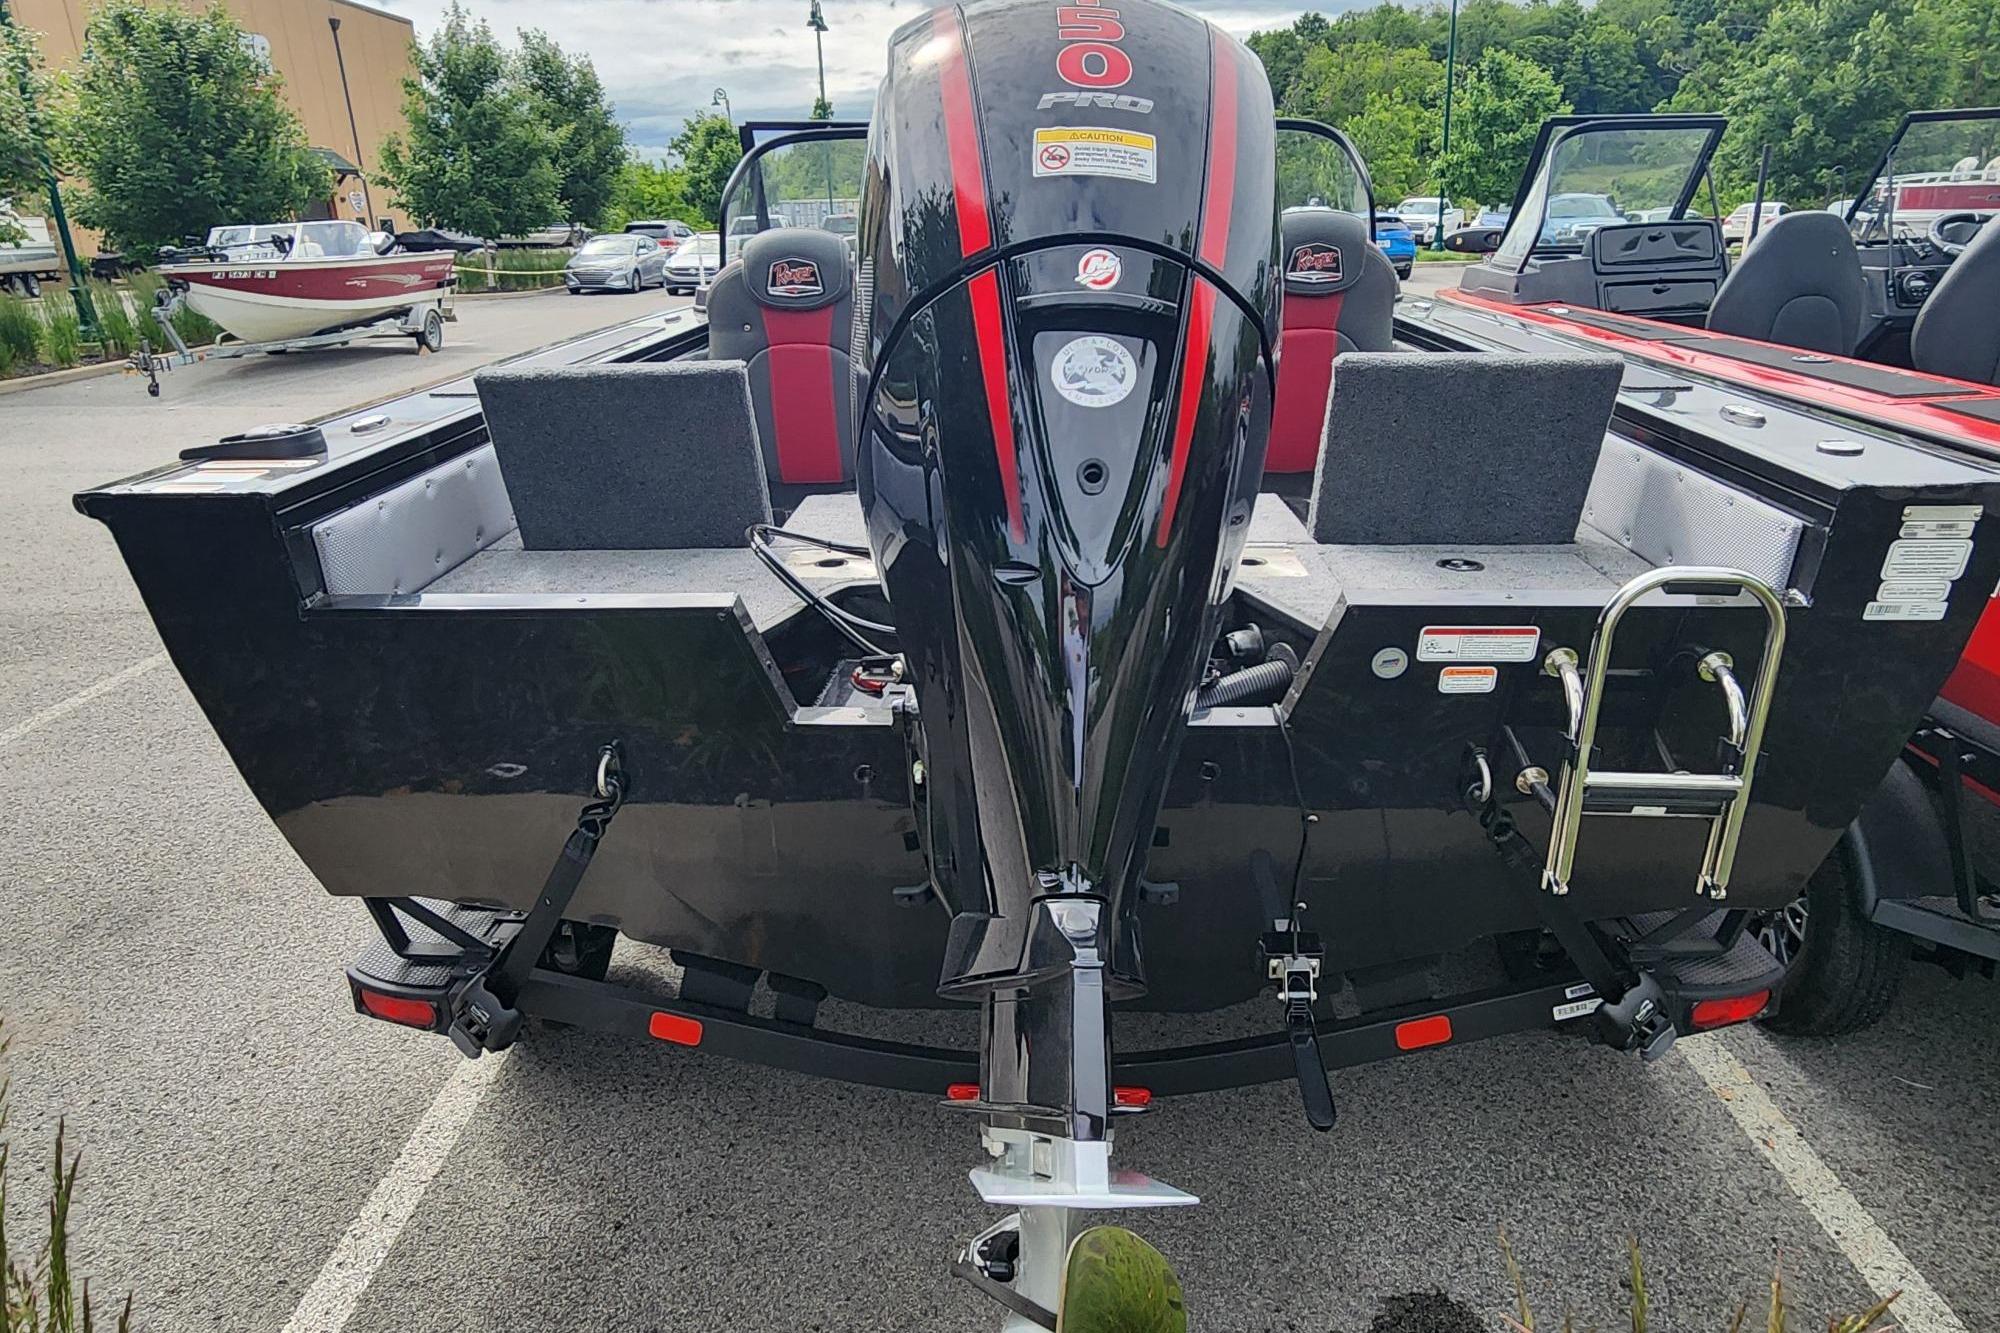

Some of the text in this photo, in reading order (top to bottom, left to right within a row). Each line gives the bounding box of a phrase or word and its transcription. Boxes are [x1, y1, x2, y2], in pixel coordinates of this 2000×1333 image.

[1056, 0, 1133, 89] 50
[1036, 91, 1154, 114] PRO
[1079, 132, 1124, 143] CAUTION
